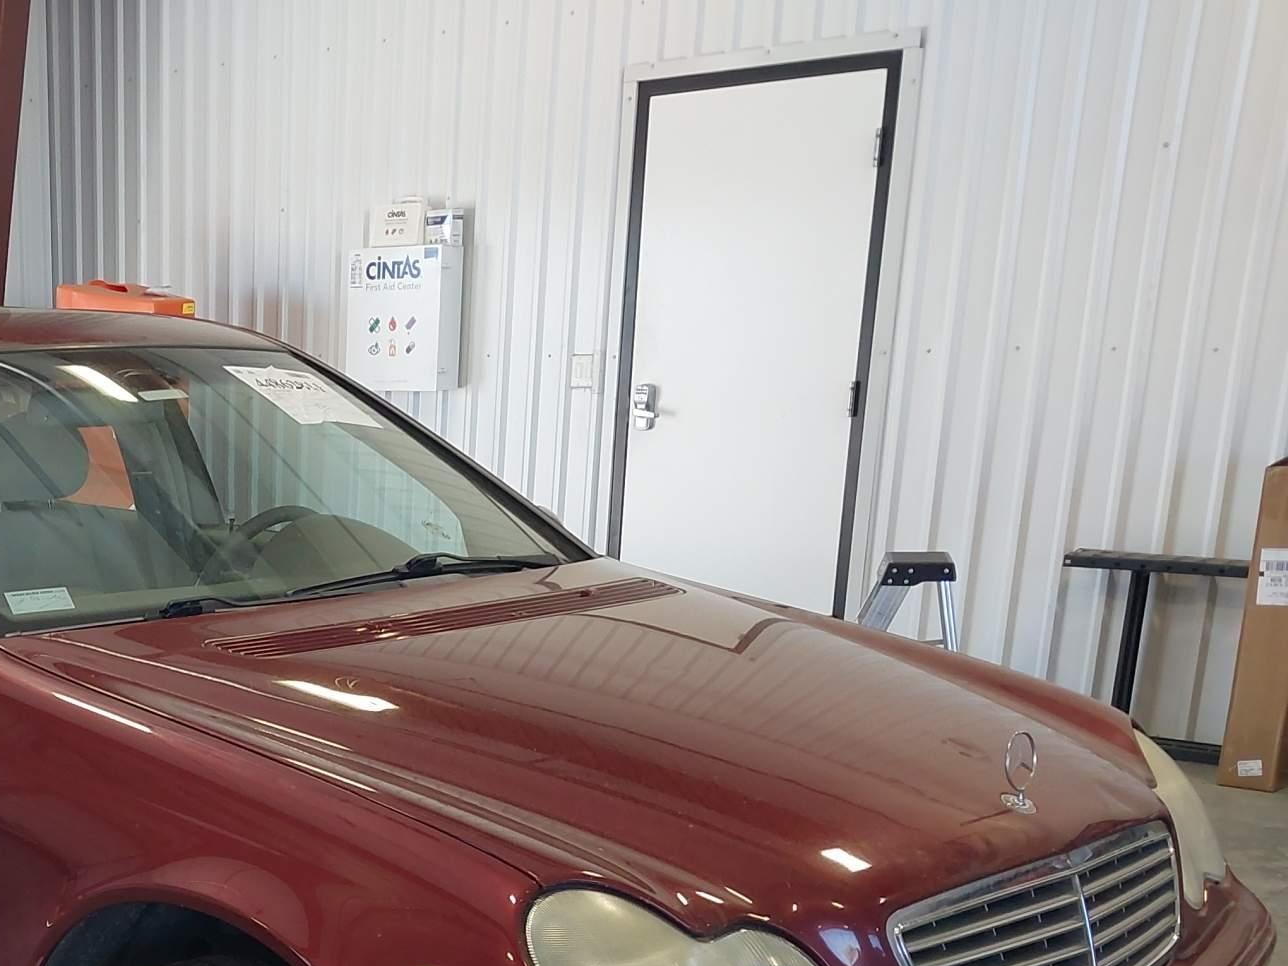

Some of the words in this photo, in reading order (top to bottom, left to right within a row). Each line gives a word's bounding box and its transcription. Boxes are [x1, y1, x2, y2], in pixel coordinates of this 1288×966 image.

[365, 283, 381, 292] First
[383, 282, 396, 291] Aid
[397, 282, 422, 291] Center
